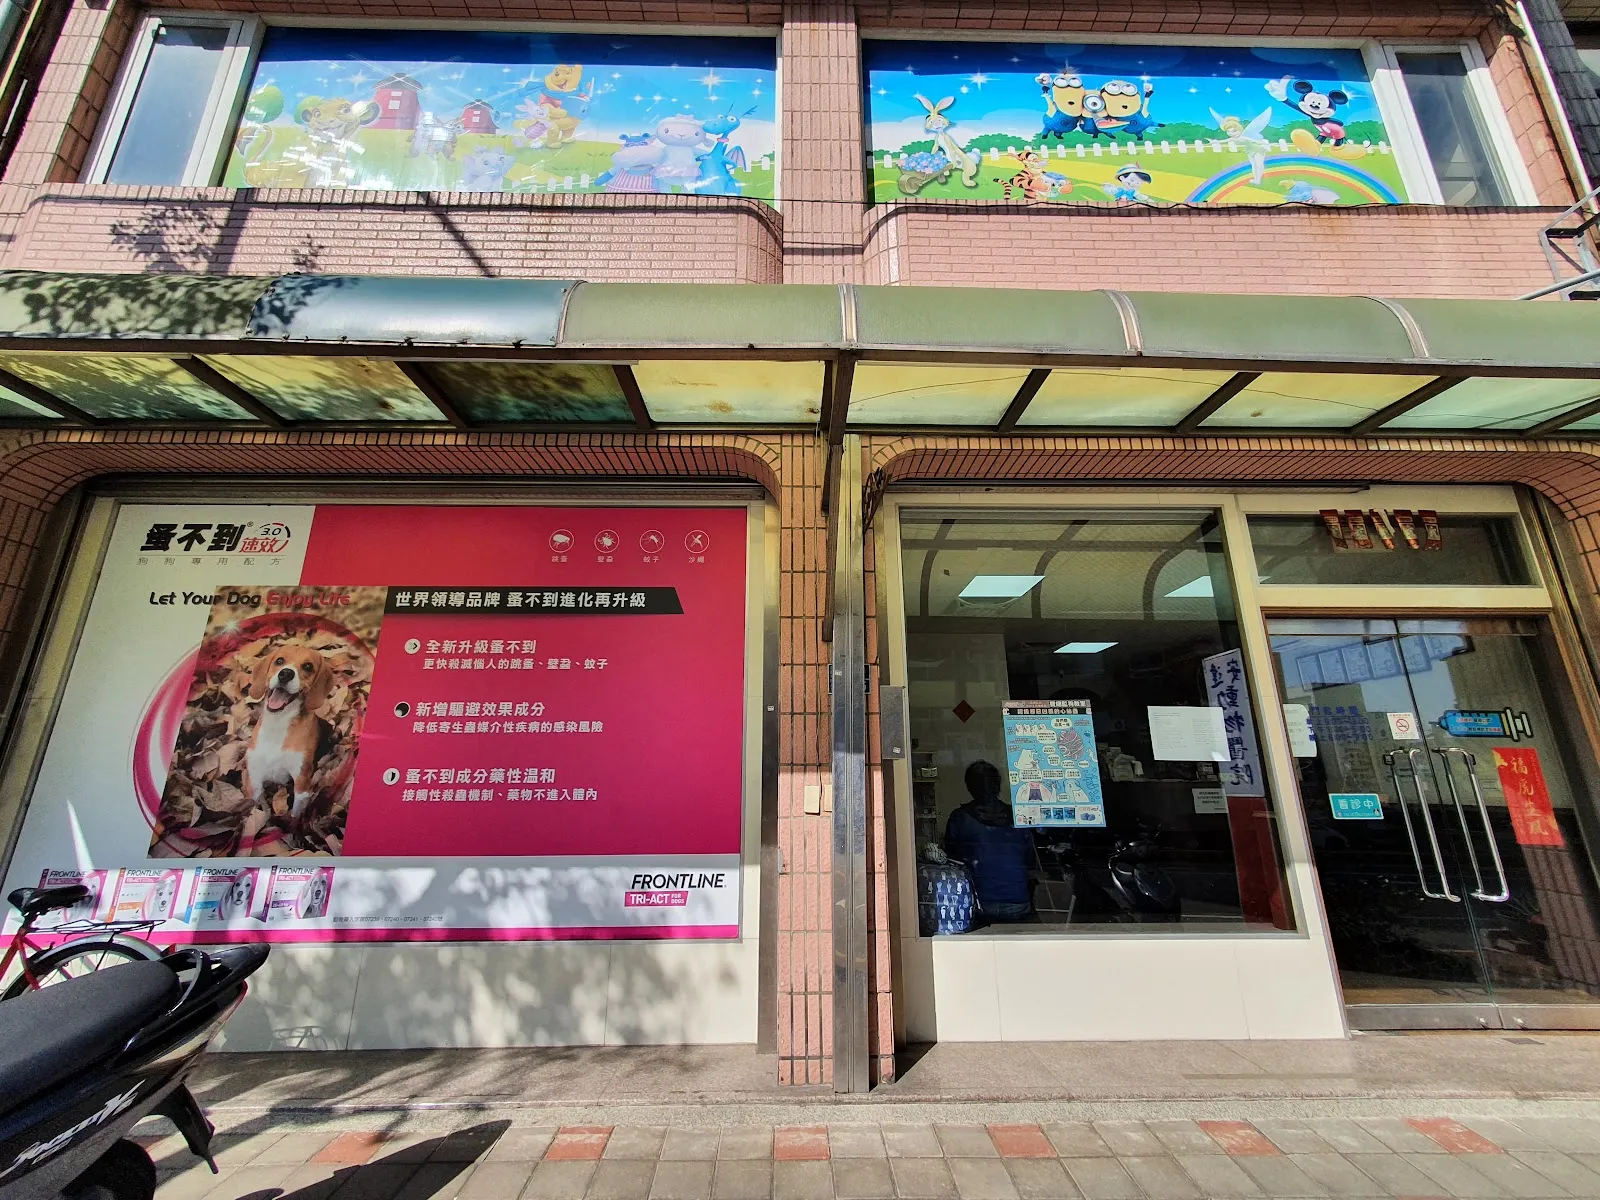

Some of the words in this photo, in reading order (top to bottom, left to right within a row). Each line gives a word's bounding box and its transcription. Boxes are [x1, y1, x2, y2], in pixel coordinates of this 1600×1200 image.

[260, 527, 282, 536] 3.0
[239, 537, 279, 553] 速效
[643, 555, 660, 563] 蚊子
[150, 591, 177, 605] Let
[182, 591, 221, 605] Your
[226, 591, 262, 608] Dog
[266, 591, 314, 608] Enjoy
[319, 592, 351, 606] Life
[395, 591, 501, 608] 世界領導品牌
[506, 591, 646, 608] 蚤不到進化再升級
[426, 639, 537, 654] 全新升級蚤不到
[415, 701, 546, 717] 新增驅避效果成分
[125, 868, 164, 877] FRONTLINE
[202, 867, 240, 876] FRONTLINE
[277, 867, 316, 875] FRONTLINE
[631, 873, 725, 889] FRONTLINE
[630, 893, 670, 905] TRI-ACT
